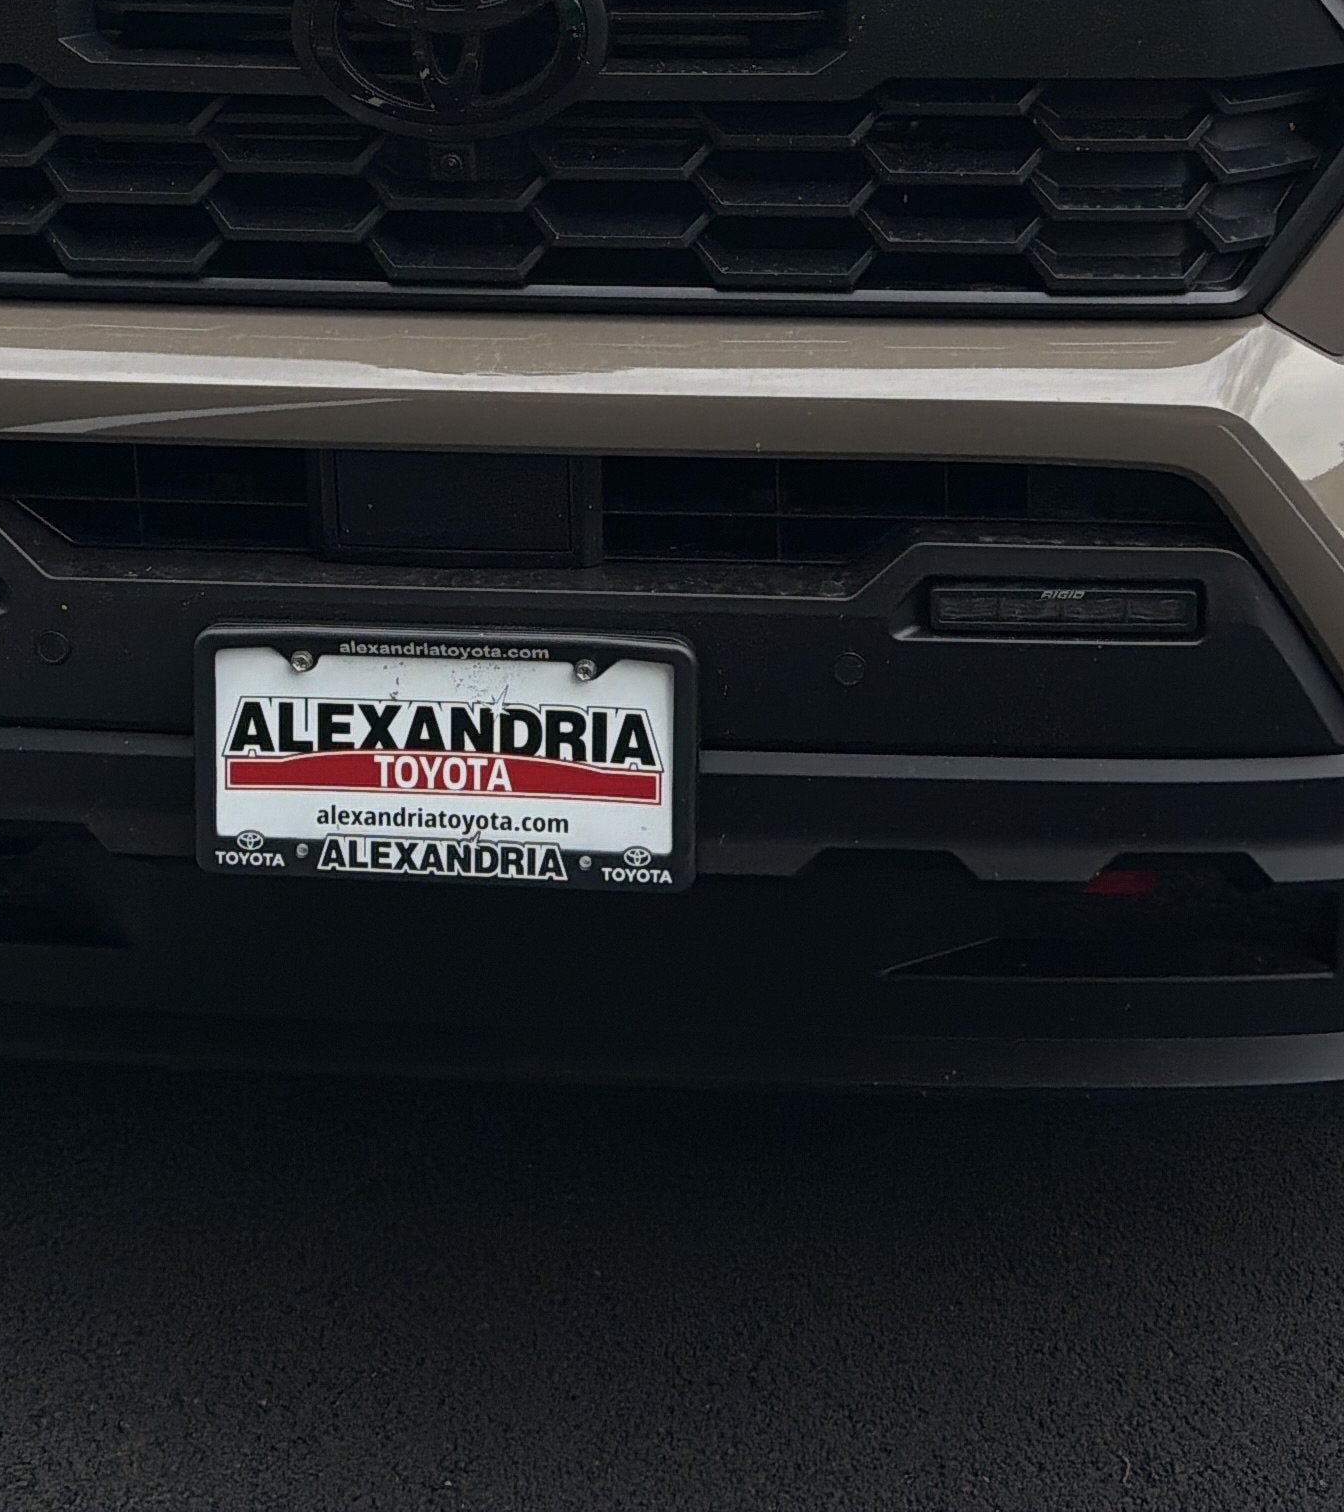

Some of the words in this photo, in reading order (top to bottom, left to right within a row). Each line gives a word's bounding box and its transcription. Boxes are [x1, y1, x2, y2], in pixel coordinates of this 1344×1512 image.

[339, 640, 549, 660] alexandriatoyota.com
[226, 699, 660, 769] ALEXANDRIA
[374, 755, 513, 792] TOYOTA
[316, 804, 570, 835] alexandriatoyota.com
[214, 850, 285, 869] TOYOTA
[318, 835, 567, 880] ALEXANDRIA
[601, 867, 673, 885] TOYOTA
